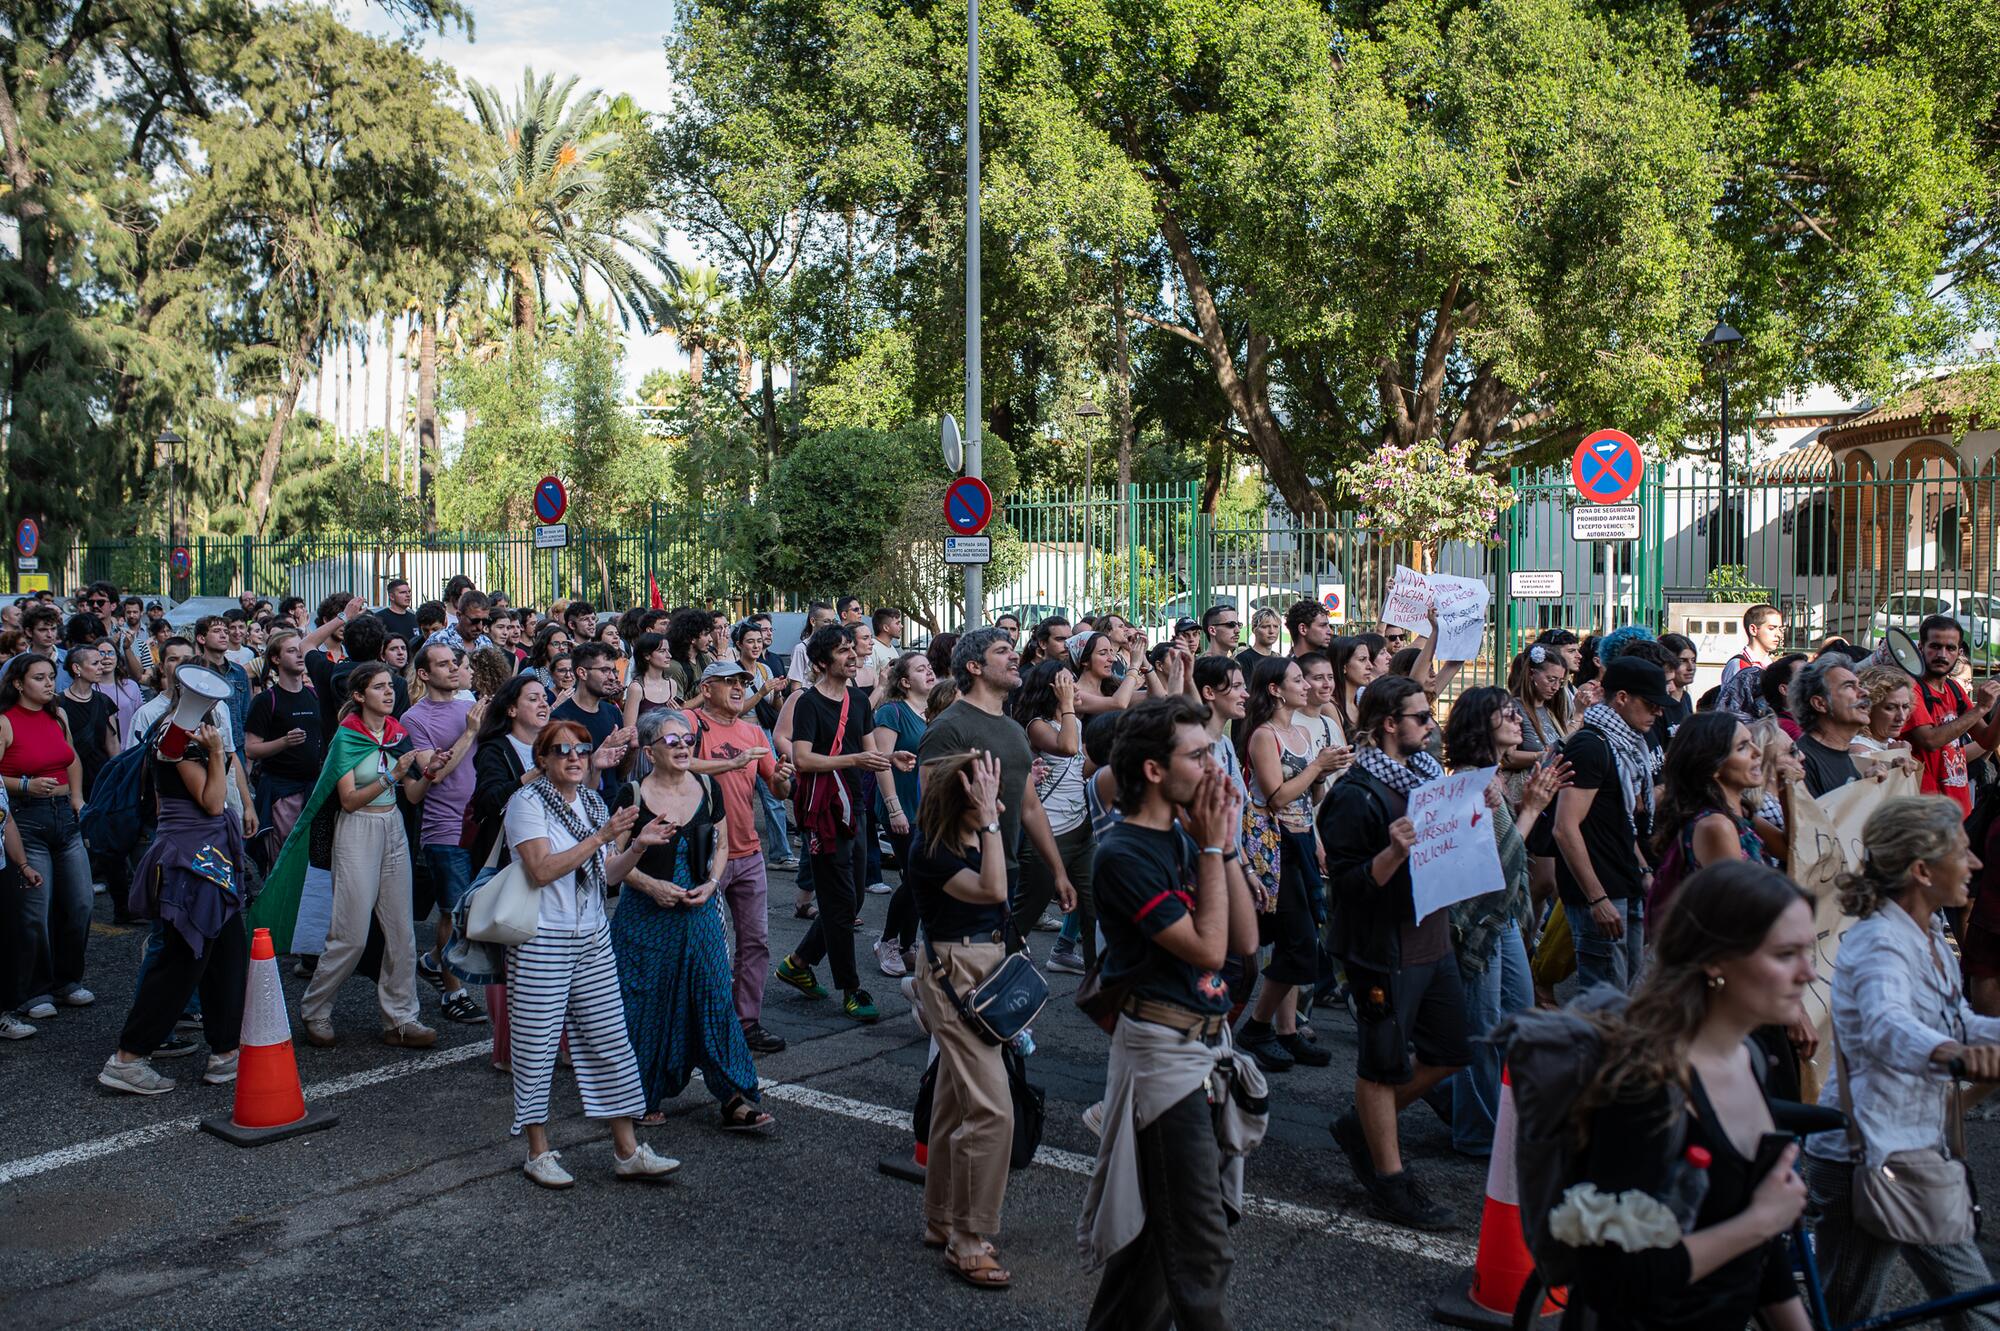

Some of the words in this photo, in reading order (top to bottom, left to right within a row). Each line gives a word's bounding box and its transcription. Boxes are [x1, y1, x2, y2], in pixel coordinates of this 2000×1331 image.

[1398, 569, 1427, 589] VIVA
[1394, 585, 1424, 601] LUCHA
[1389, 596, 1417, 613] PUEBLO
[1393, 613, 1429, 623] PALESTIN
[1413, 784, 1445, 816] BASTA
[1425, 809, 1439, 825] DE
[1415, 814, 1459, 845] EPRESIÓN
[1412, 838, 1459, 871] POLICIAL
